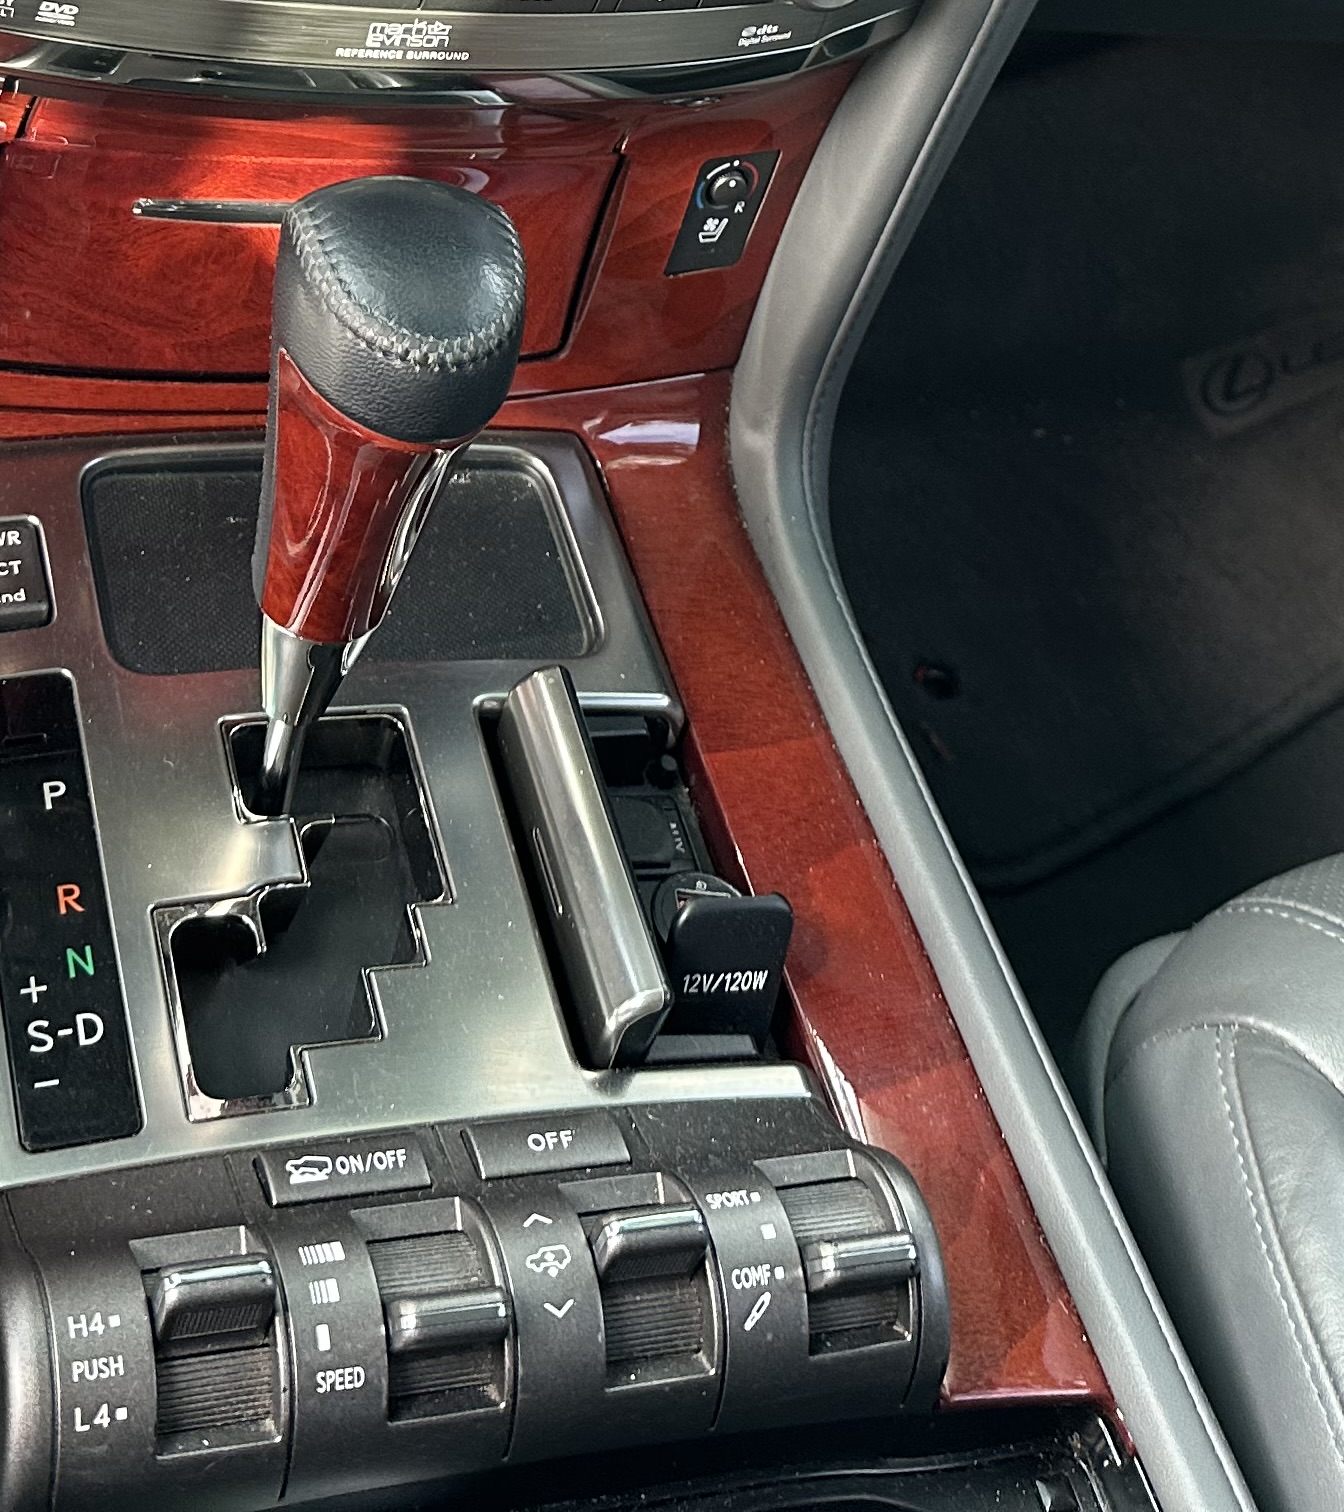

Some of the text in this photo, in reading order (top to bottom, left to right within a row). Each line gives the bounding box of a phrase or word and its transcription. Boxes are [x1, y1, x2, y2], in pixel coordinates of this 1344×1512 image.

[39, 0, 80, 15] DVD
[336, 48, 470, 61] REFERENCE SURROUND
[734, 201, 745, 214] R
[42, 780, 67, 810] P
[57, 884, 85, 915] R
[66, 945, 95, 979] N
[683, 969, 769, 993] 12V/120W
[527, 1129, 573, 1152] OFF
[335, 1148, 407, 1176] ON/OFF
[705, 1189, 750, 1210] SPORT
[731, 1263, 771, 1290] COMF
[66, 1311, 106, 1339] H4
[71, 1354, 125, 1383] PUSH
[315, 1366, 366, 1394] SPEED
